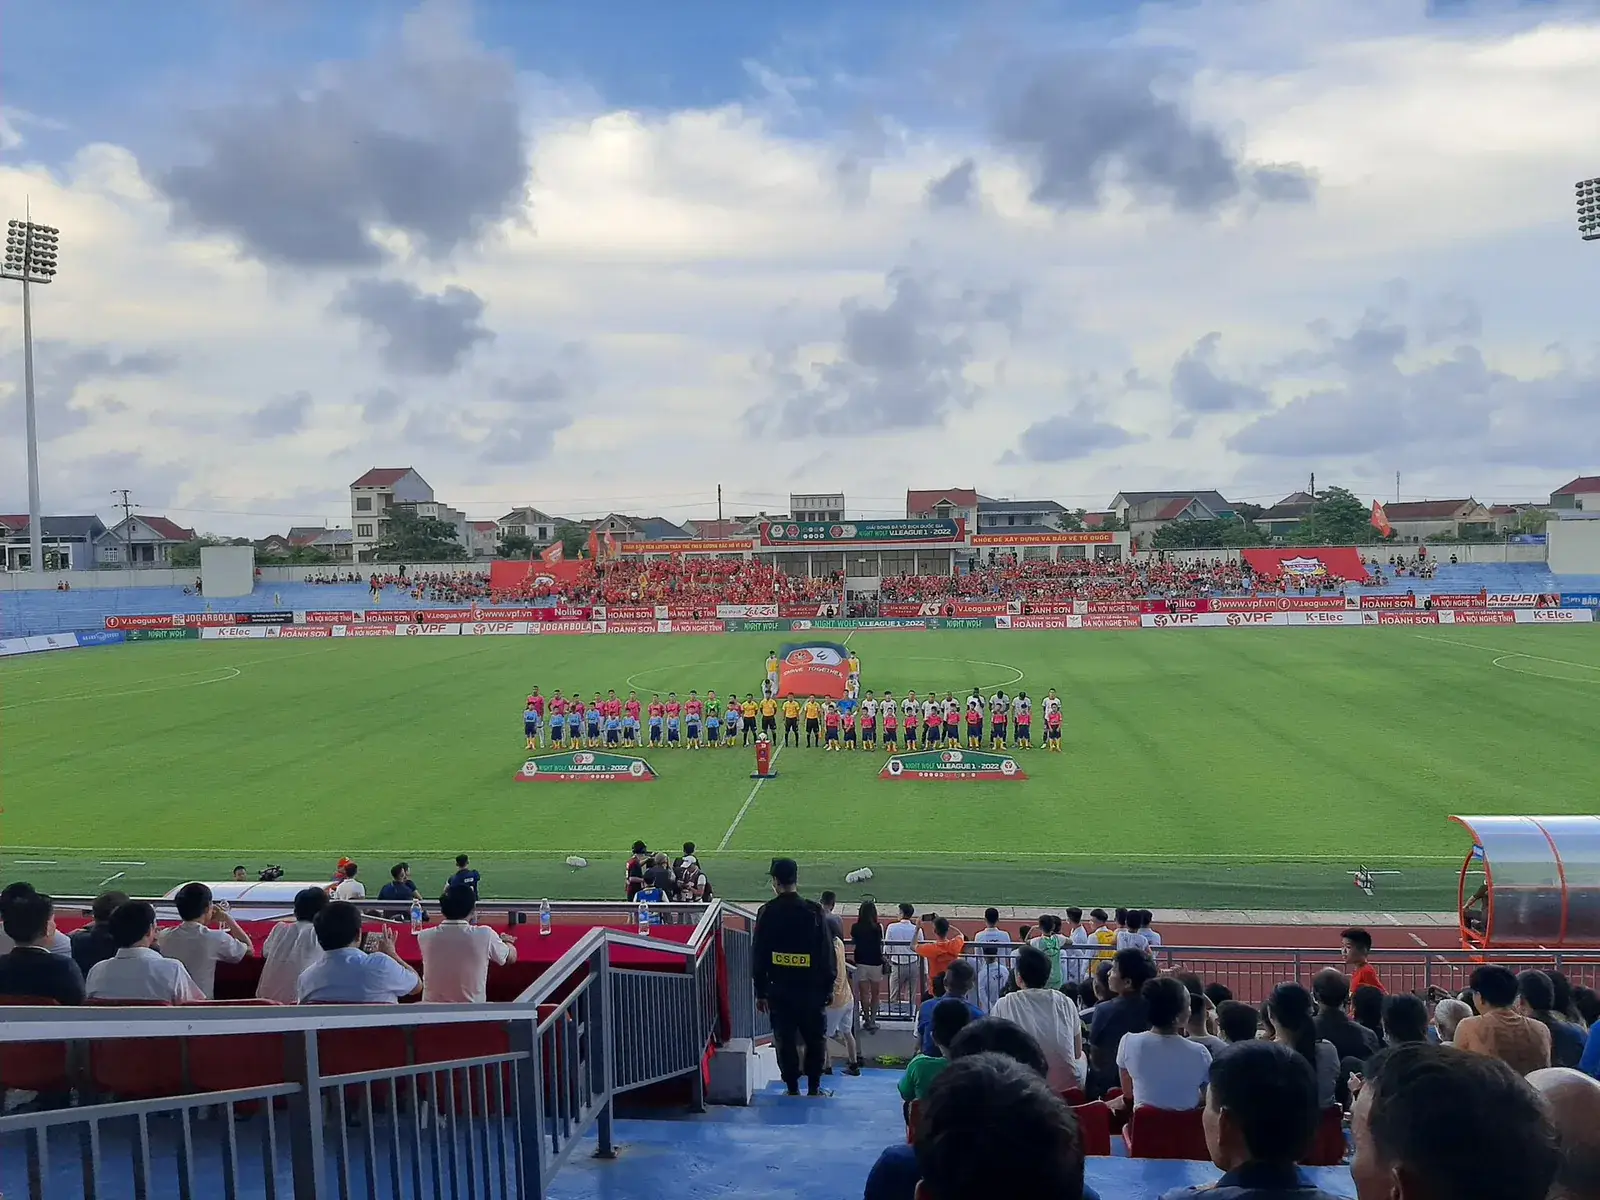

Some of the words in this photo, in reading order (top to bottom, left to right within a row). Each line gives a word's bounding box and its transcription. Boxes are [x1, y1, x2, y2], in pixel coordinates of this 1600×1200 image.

[1221, 600, 1276, 609] www.vpf.vn
[1362, 600, 1393, 608] HOÀNH
[1395, 600, 1413, 608] SƠN
[484, 610, 532, 619] www.vpf.vn
[554, 608, 582, 616] Noliko
[1306, 612, 1343, 621] K-Elec
[1534, 611, 1573, 619] K-Elec
[185, 613, 235, 622] JOGARBOLA
[1169, 614, 1199, 623] VPF
[1242, 613, 1273, 622] VPF
[1381, 615, 1413, 624] HOÀNH
[1416, 615, 1435, 624] SƠN
[487, 623, 514, 632] VPF
[541, 623, 592, 631] JOGARBOLA
[1013, 619, 1043, 628] HOÀNH
[218, 628, 250, 636] K-Elec
[420, 624, 447, 633] VPF
[775, 954, 807, 964] CSCĐ
